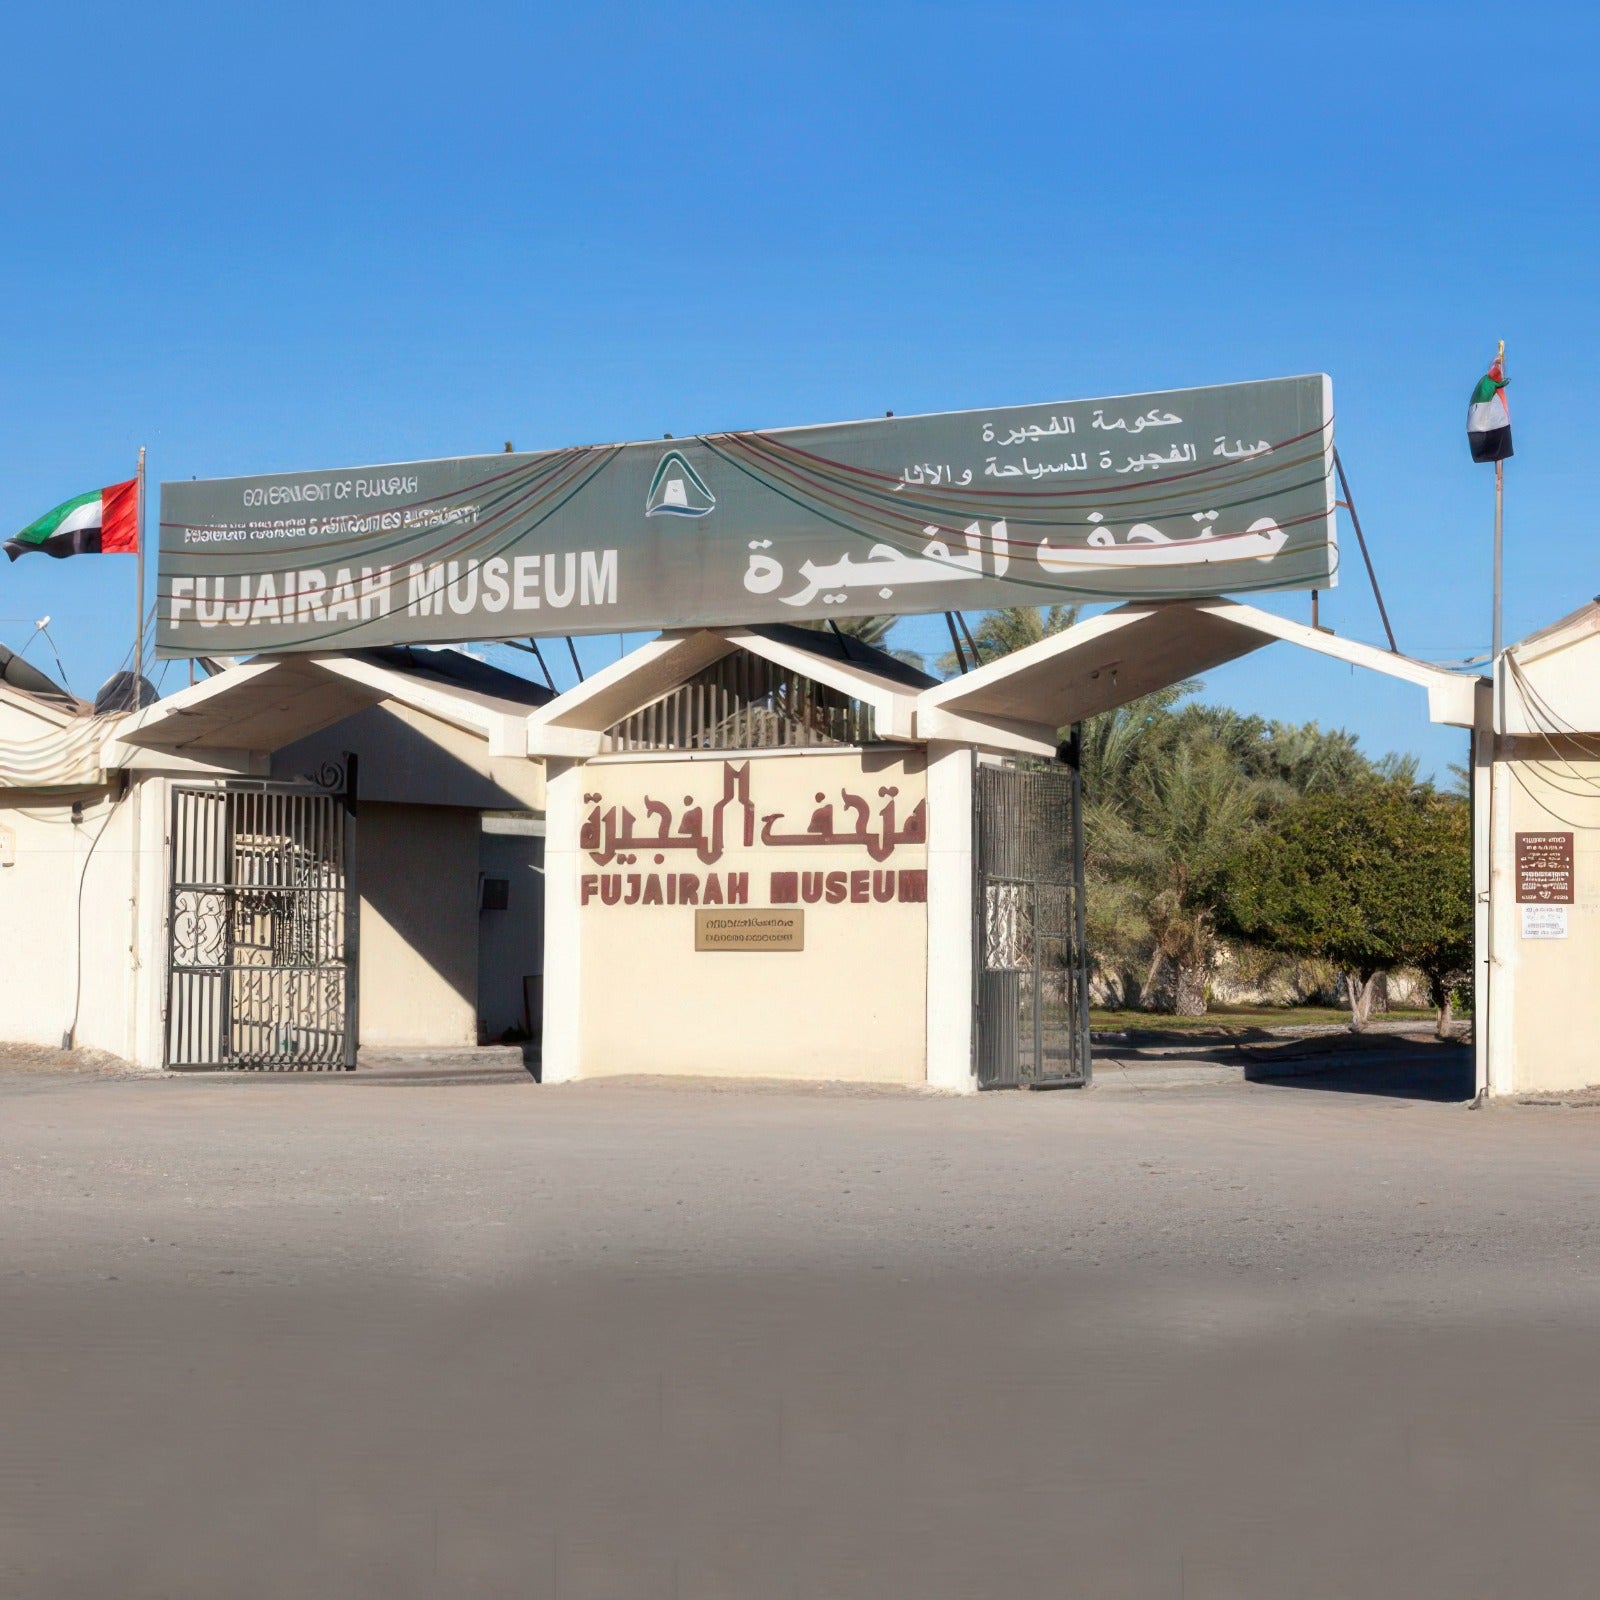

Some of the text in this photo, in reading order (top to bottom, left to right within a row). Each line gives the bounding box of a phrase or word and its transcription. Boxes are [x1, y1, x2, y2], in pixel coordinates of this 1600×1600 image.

[982, 409, 1183, 446] حكومة الفجيرة
[1099, 444, 1197, 473] الفجيرة
[743, 510, 1290, 607] متحف الفجيرة
[170, 549, 619, 630] FUJAIRAH MUSEUM
[580, 760, 926, 867] متحف الفجيرة
[580, 872, 749, 906] FUJAIRAH
